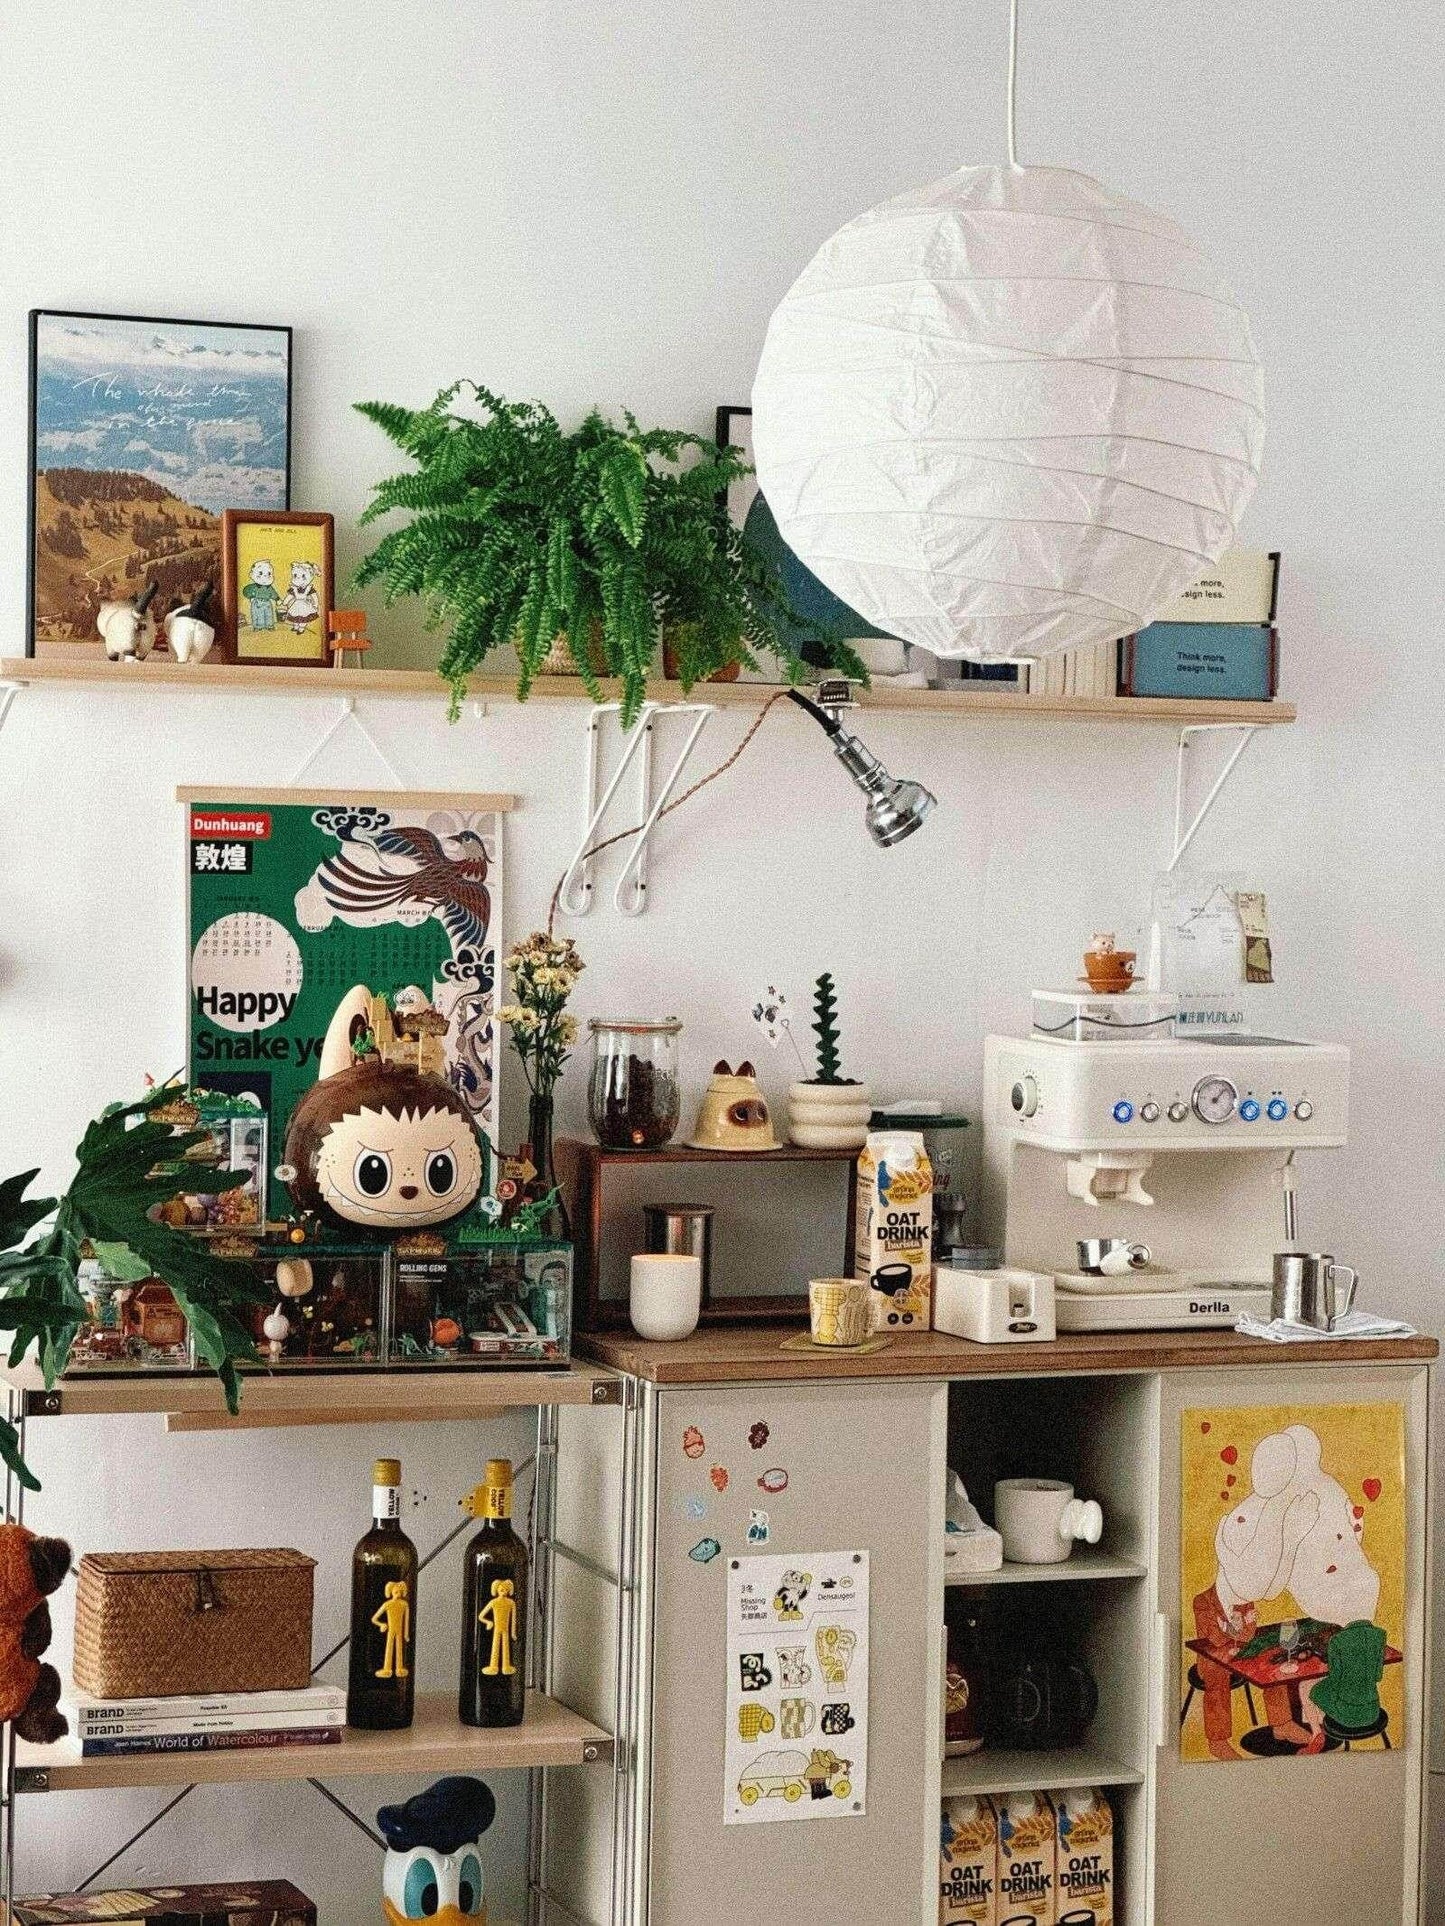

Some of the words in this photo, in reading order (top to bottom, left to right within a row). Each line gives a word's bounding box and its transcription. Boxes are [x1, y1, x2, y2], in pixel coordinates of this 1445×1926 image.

[1181, 590, 1203, 600] sign
[1177, 651, 1200, 662] Think
[1176, 663, 1205, 675] design
[194, 817, 264, 834] Dunhuang
[195, 844, 247, 872] 敦煌
[197, 986, 297, 1022] Happy
[196, 1030, 290, 1060] Snake
[886, 1212, 920, 1226] OAT
[877, 1226, 930, 1240] DRINK
[399, 1264, 428, 1272] ROLLING
[1189, 1302, 1230, 1314] Derlla
[154, 1737, 188, 1749] World
[192, 1736, 204, 1748] of
[208, 1733, 280, 1747] Watercolour
[1009, 1861, 1043, 1877] OAT
[1068, 1856, 1101, 1872] OAT
[951, 1865, 984, 1881] OAT
[1060, 1869, 1111, 1887] DRINK
[941, 1879, 993, 1897] DRINK
[1001, 1875, 1052, 1893] DRINK
